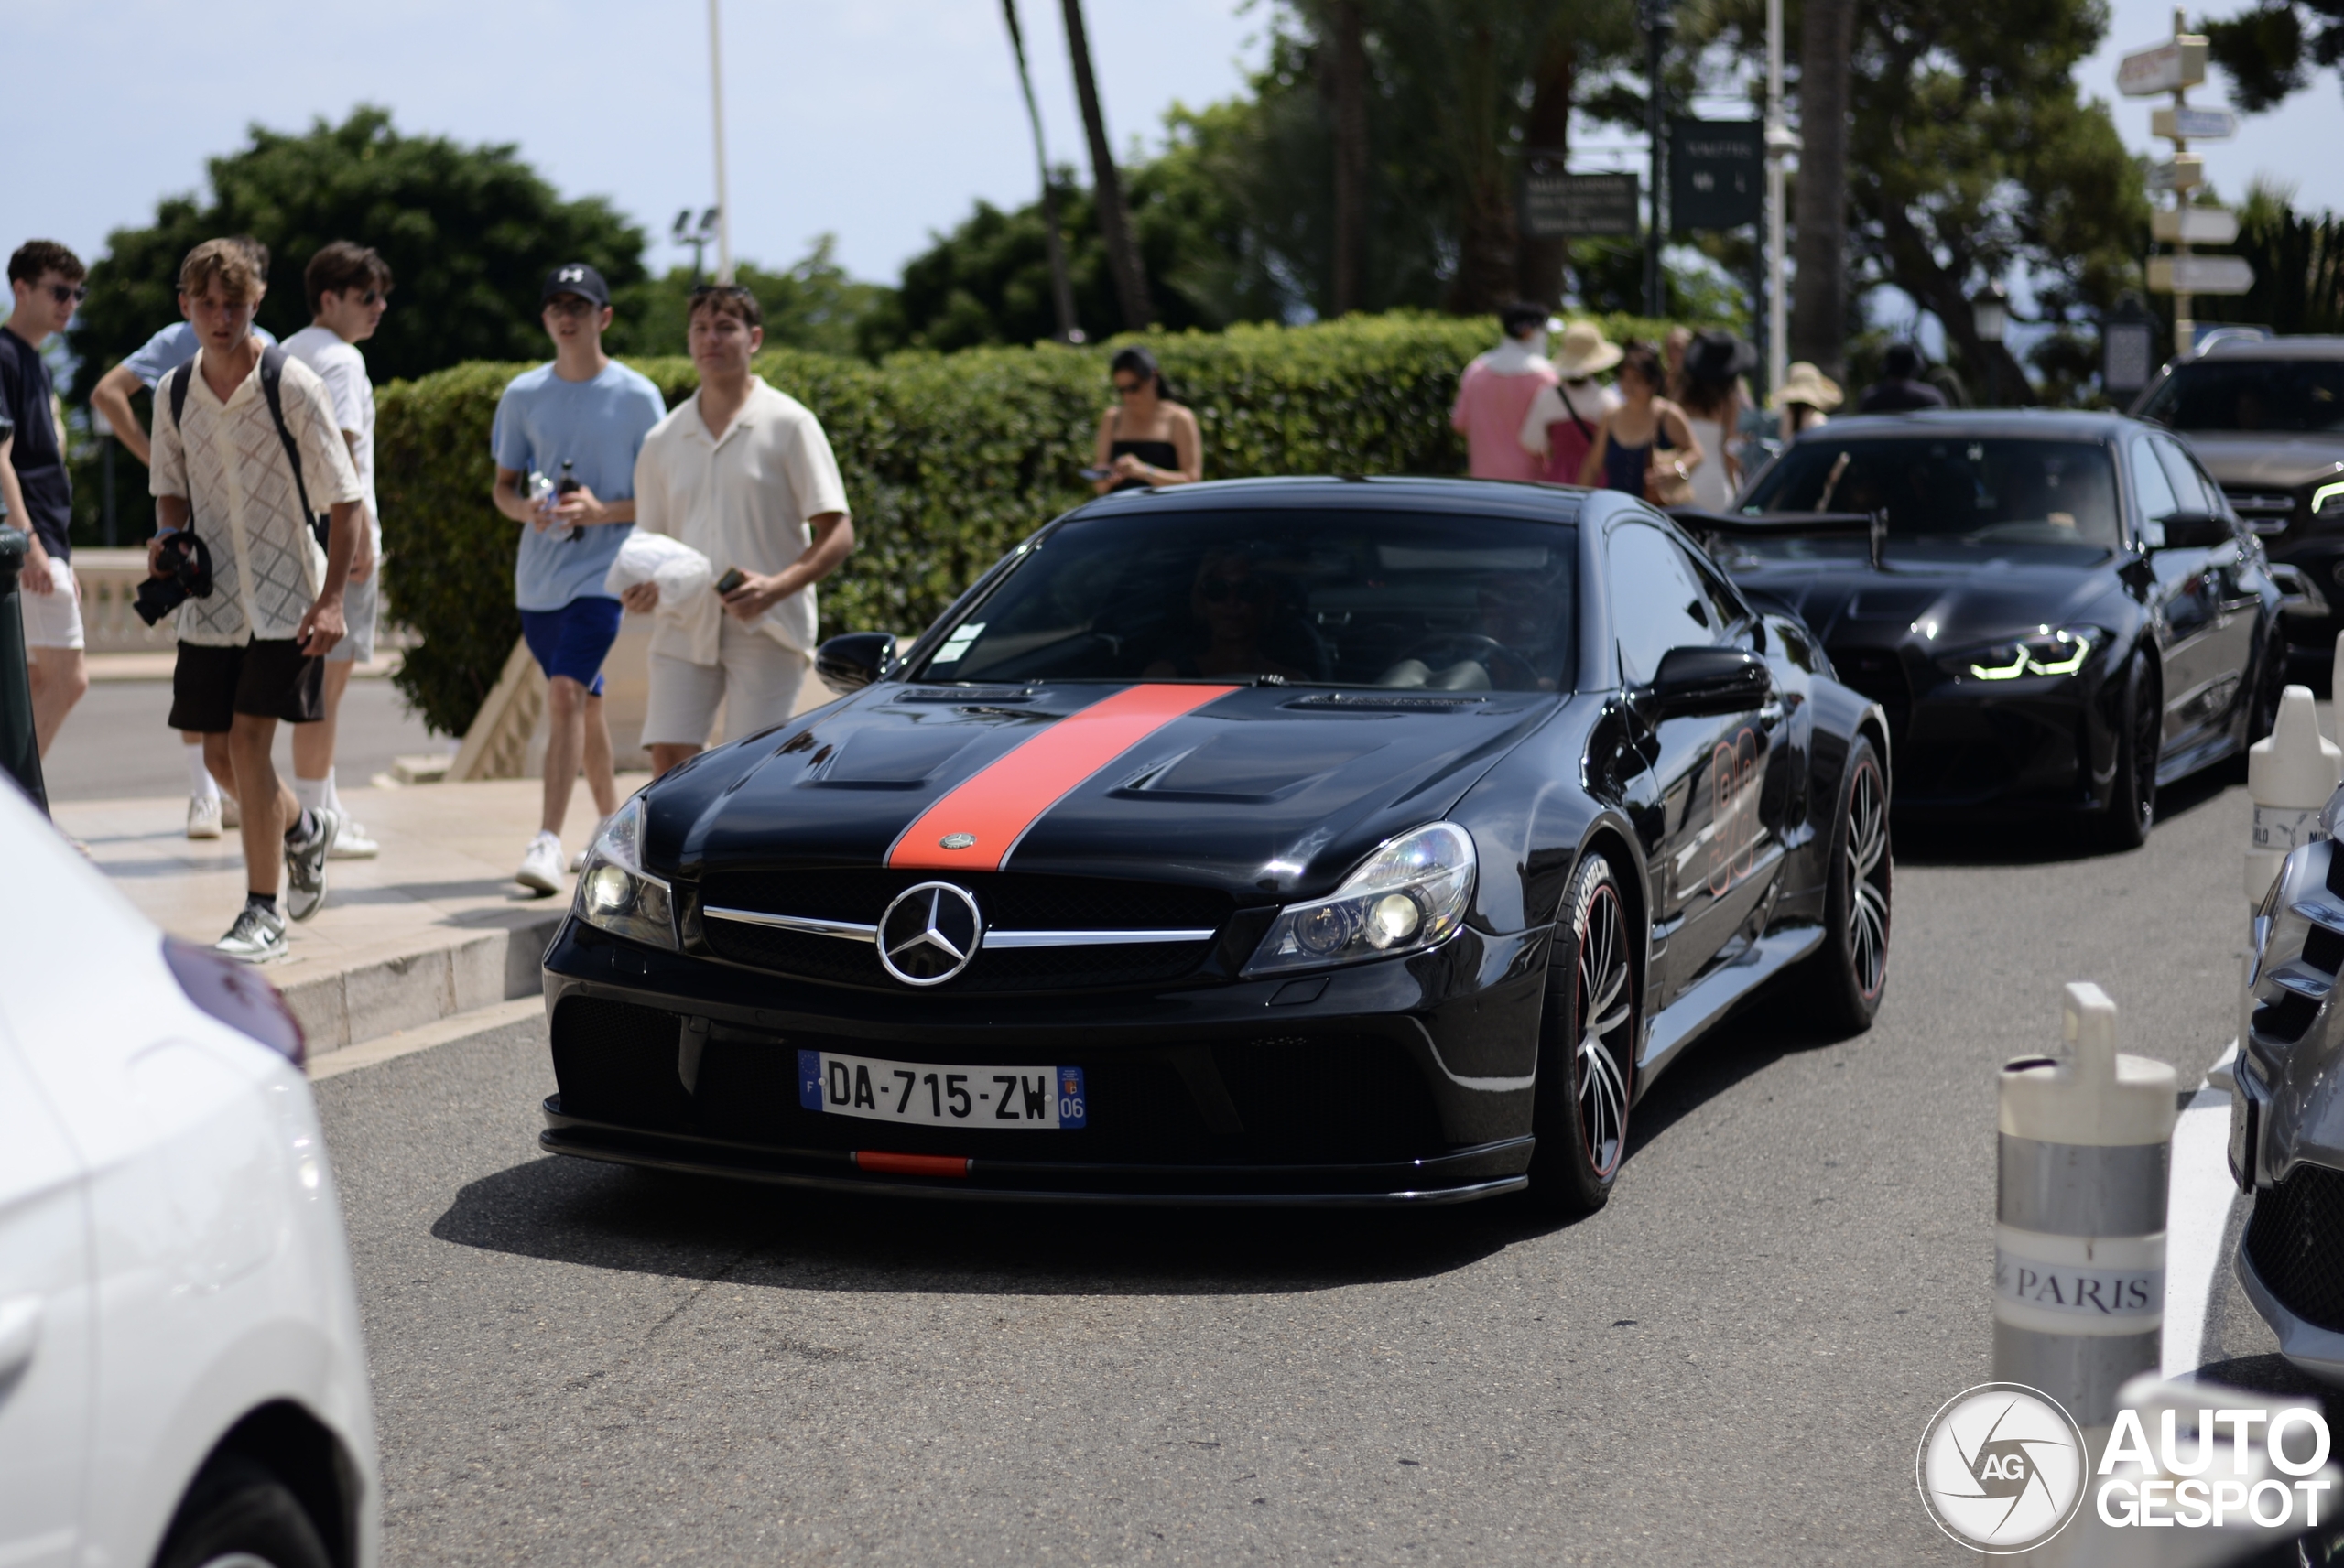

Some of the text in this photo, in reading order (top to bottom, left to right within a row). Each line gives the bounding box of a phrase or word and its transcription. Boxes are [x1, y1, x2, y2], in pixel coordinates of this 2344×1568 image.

[1572, 859, 1609, 942] MICHELIN
[806, 1081, 814, 1093] F
[828, 1060, 1046, 1119] DA-715-ZW
[1060, 1098, 1084, 1118] 06
[2016, 1268, 2148, 1314] PARIS
